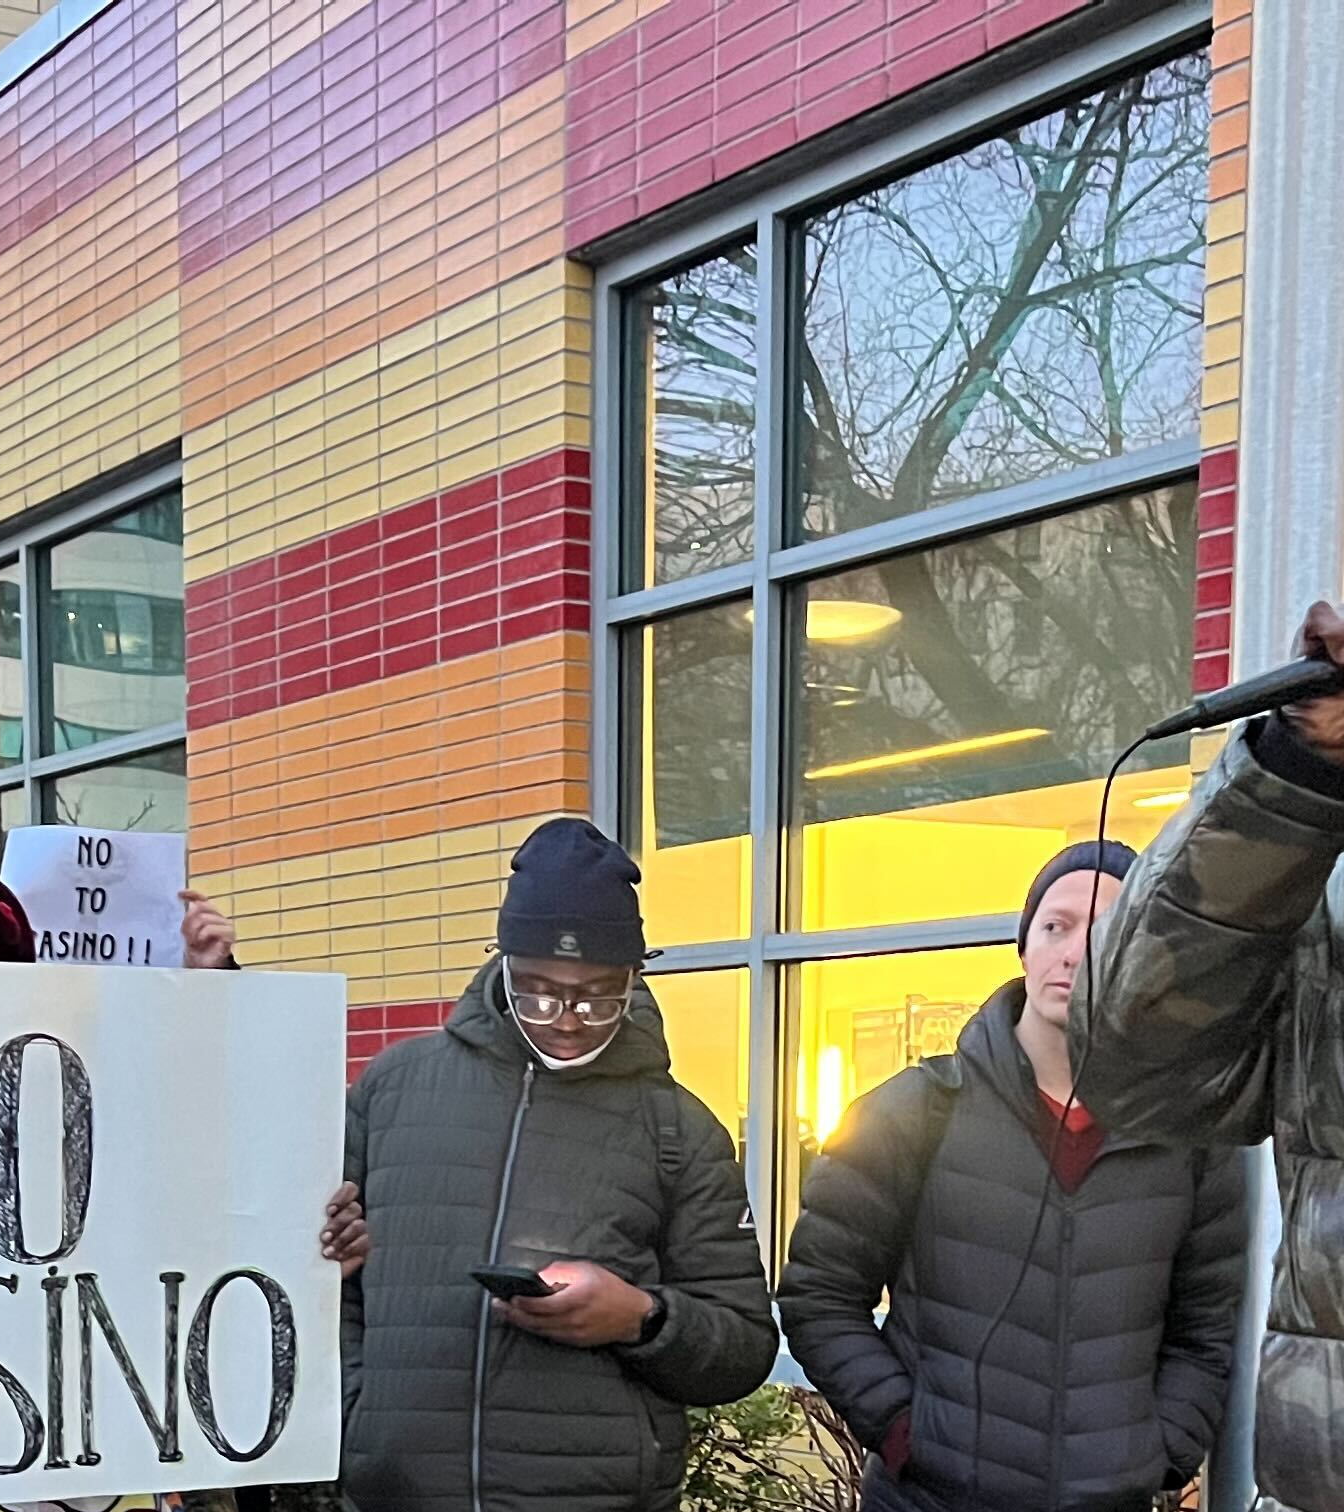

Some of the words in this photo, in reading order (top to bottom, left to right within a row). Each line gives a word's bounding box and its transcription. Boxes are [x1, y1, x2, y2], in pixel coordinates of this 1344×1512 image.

[77, 836, 112, 867] NO
[76, 886, 107, 915] TO
[37, 930, 116, 961] ASINO
